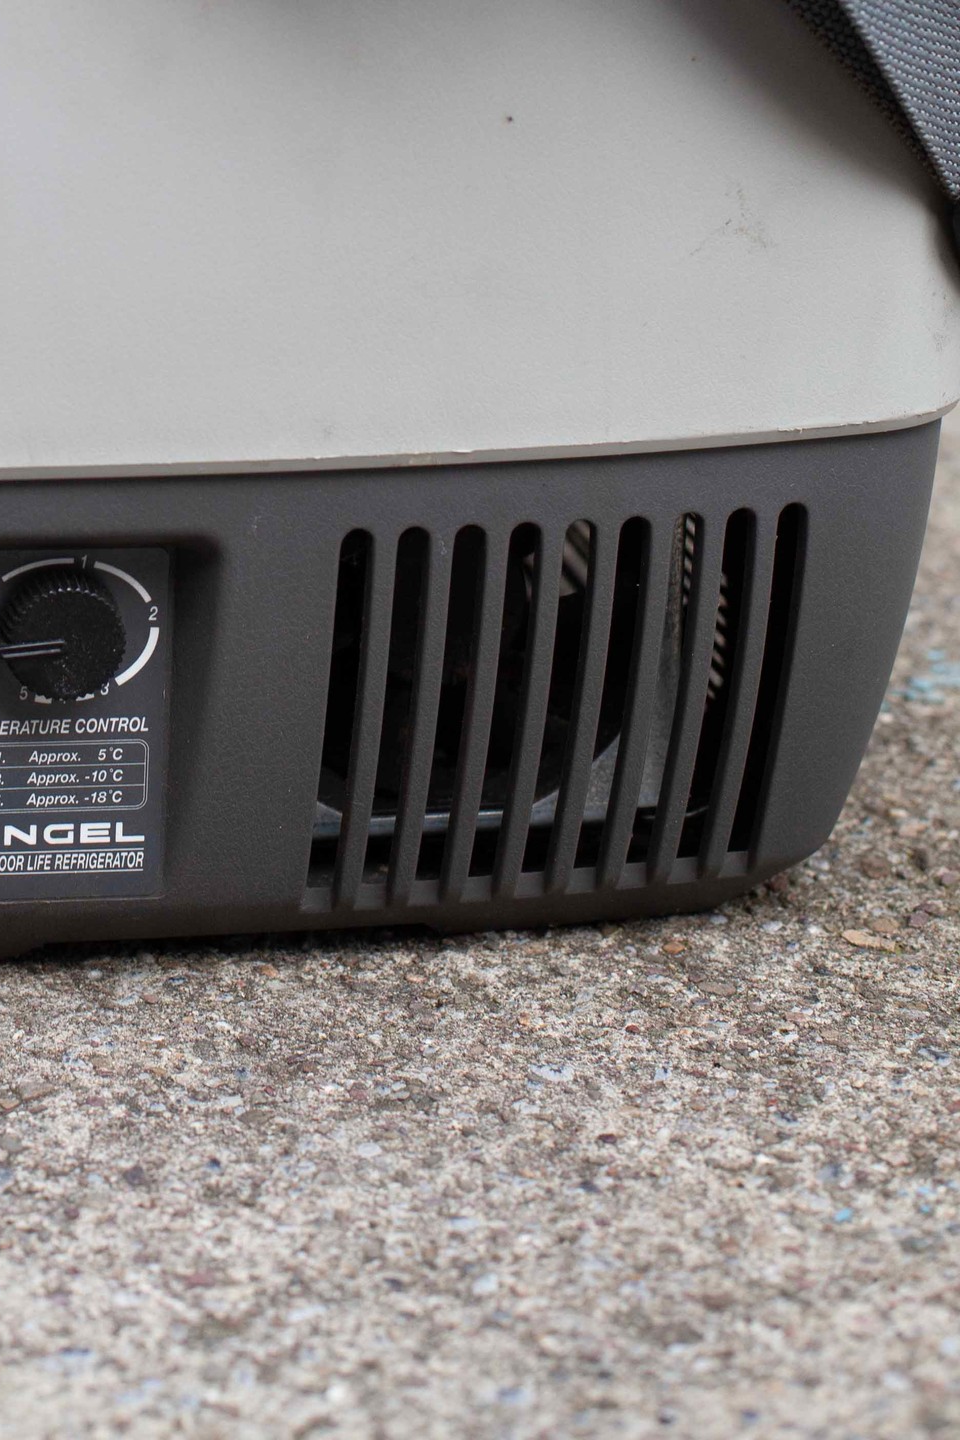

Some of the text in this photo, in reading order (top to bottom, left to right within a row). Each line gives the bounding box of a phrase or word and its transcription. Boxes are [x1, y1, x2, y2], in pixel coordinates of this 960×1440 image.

[81, 554, 88, 569] 1
[148, 606, 159, 621] 2
[19, 686, 29, 701] 5
[75, 717, 149, 733] CONTROL
[28, 751, 81, 765] Approx.
[27, 772, 80, 786] Approx.
[26, 793, 79, 808] Approx.
[27, 854, 51, 871] LIFE
[54, 851, 144, 870] REFRIGERATOR
